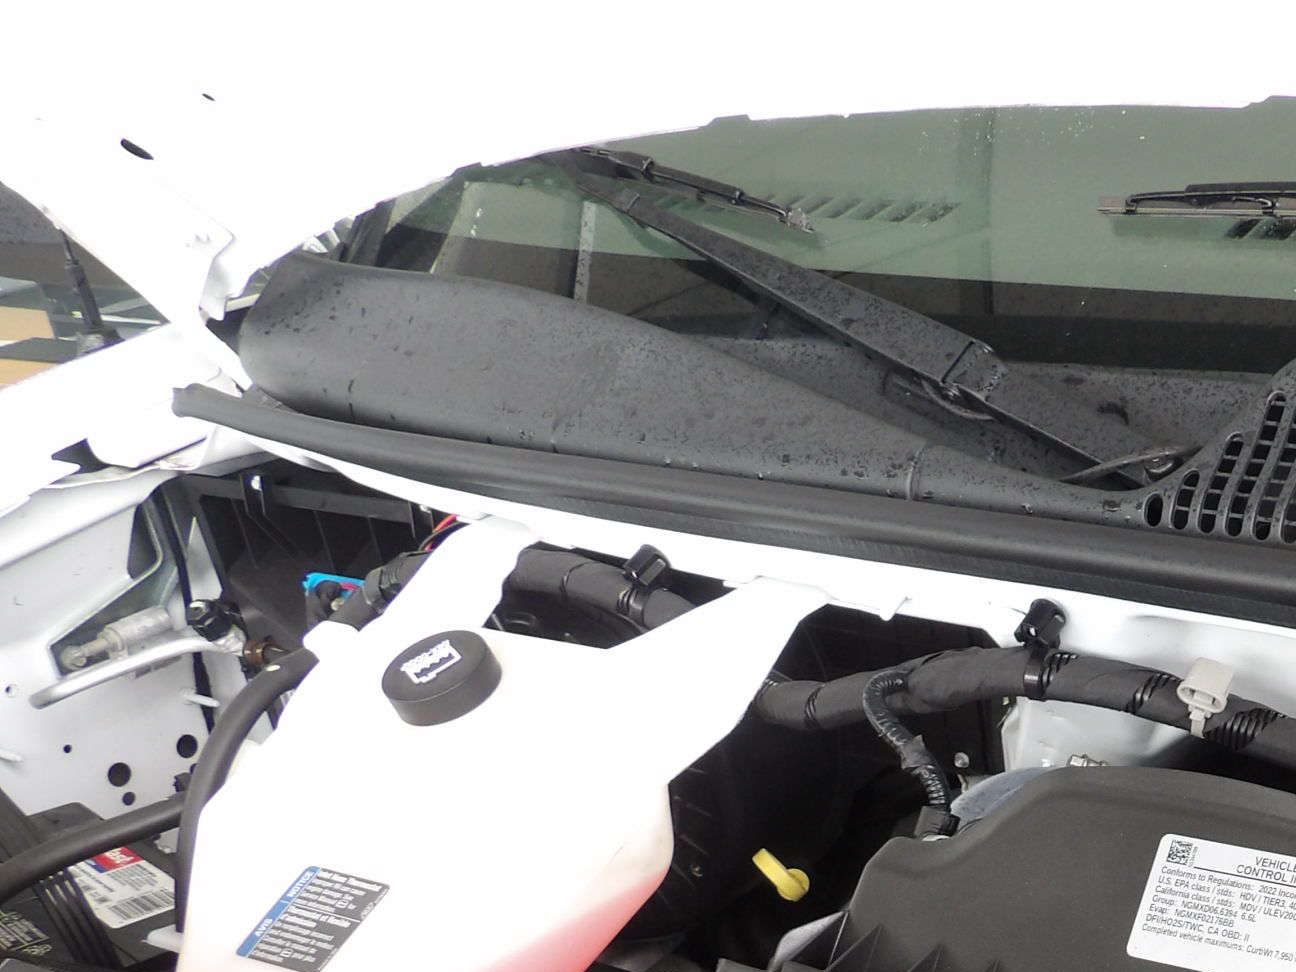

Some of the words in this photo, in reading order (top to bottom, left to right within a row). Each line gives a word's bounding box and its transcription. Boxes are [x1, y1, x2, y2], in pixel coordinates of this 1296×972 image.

[288, 871, 315, 897] NOTICE
[1161, 865, 1197, 880] Conforms
[1197, 873, 1207, 882] to
[1206, 874, 1255, 891] Regulations:
[1257, 884, 1278, 896] 2022
[1236, 864, 1288, 883] CONTROL
[1151, 894, 1178, 907] Group:
[1154, 884, 1191, 899] California
[1190, 892, 1211, 904] class
[1215, 898, 1236, 908] stds:
[1238, 901, 1259, 913] MDV
[1157, 875, 1172, 886] U.S.
[1173, 878, 1190, 889] EPA
[1190, 882, 1211, 893] class
[1215, 888, 1236, 898] stds:
[1239, 891, 1258, 902] HDV
[1263, 895, 1287, 910] TIER3,
[1148, 902, 1170, 916] Evap:
[255, 919, 273, 936] AVIS
[1207, 925, 1219, 936] CA
[1221, 928, 1243, 941] OBD:
[1141, 922, 1179, 938] Completed
[1178, 932, 1204, 943] vehicle
[1204, 937, 1242, 951] maximums:
[1246, 944, 1274, 958] CurbWt
